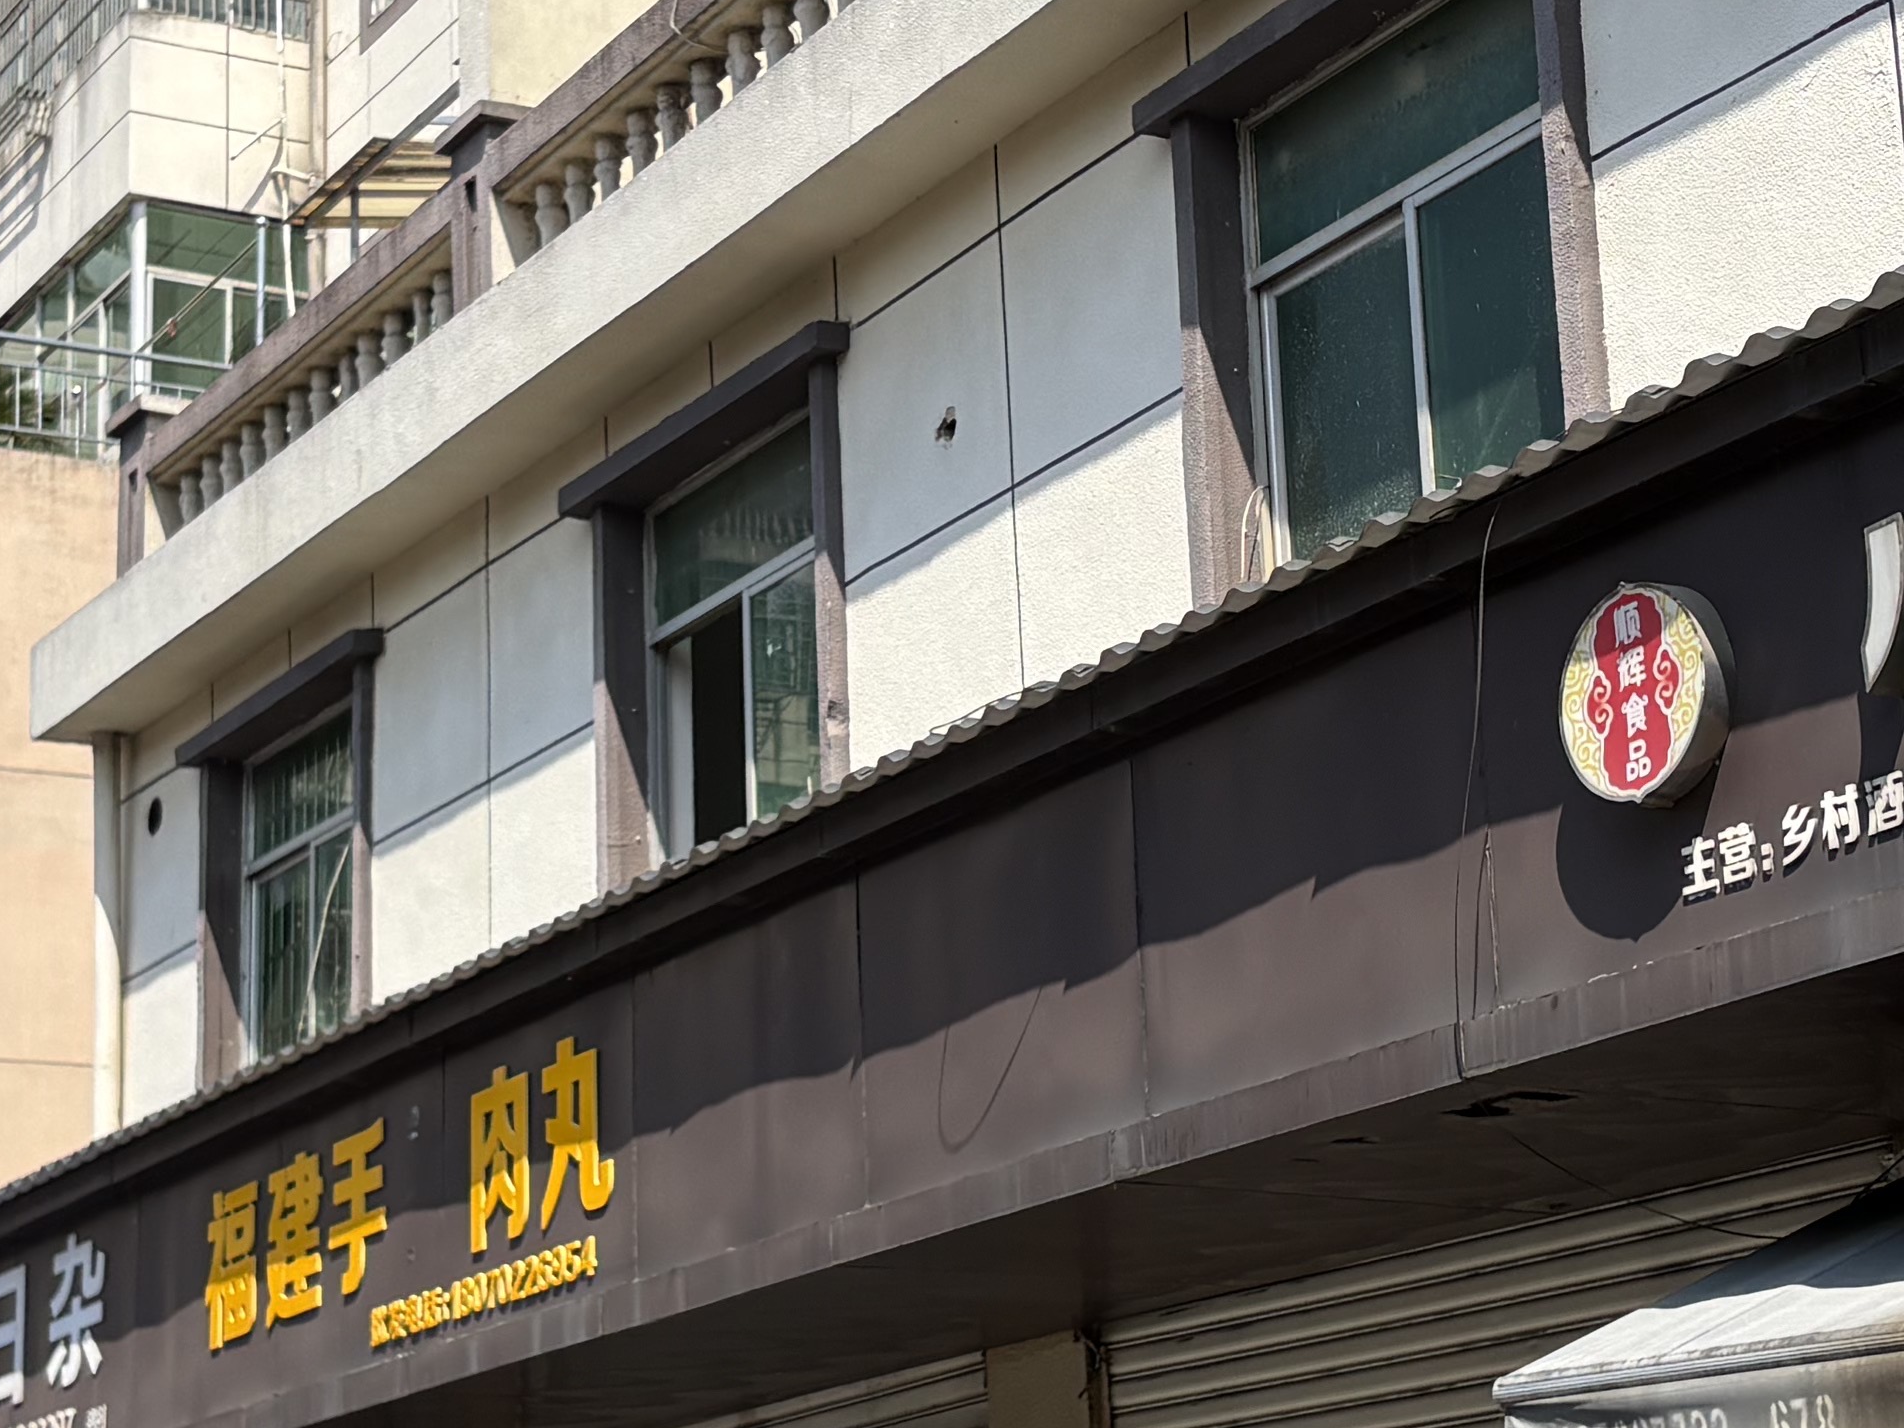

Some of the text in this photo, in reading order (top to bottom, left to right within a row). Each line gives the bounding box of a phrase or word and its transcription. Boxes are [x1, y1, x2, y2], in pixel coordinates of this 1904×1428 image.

[1613, 600, 1652, 783] 顺辉食品
[470, 1035, 616, 1254] 肉丸
